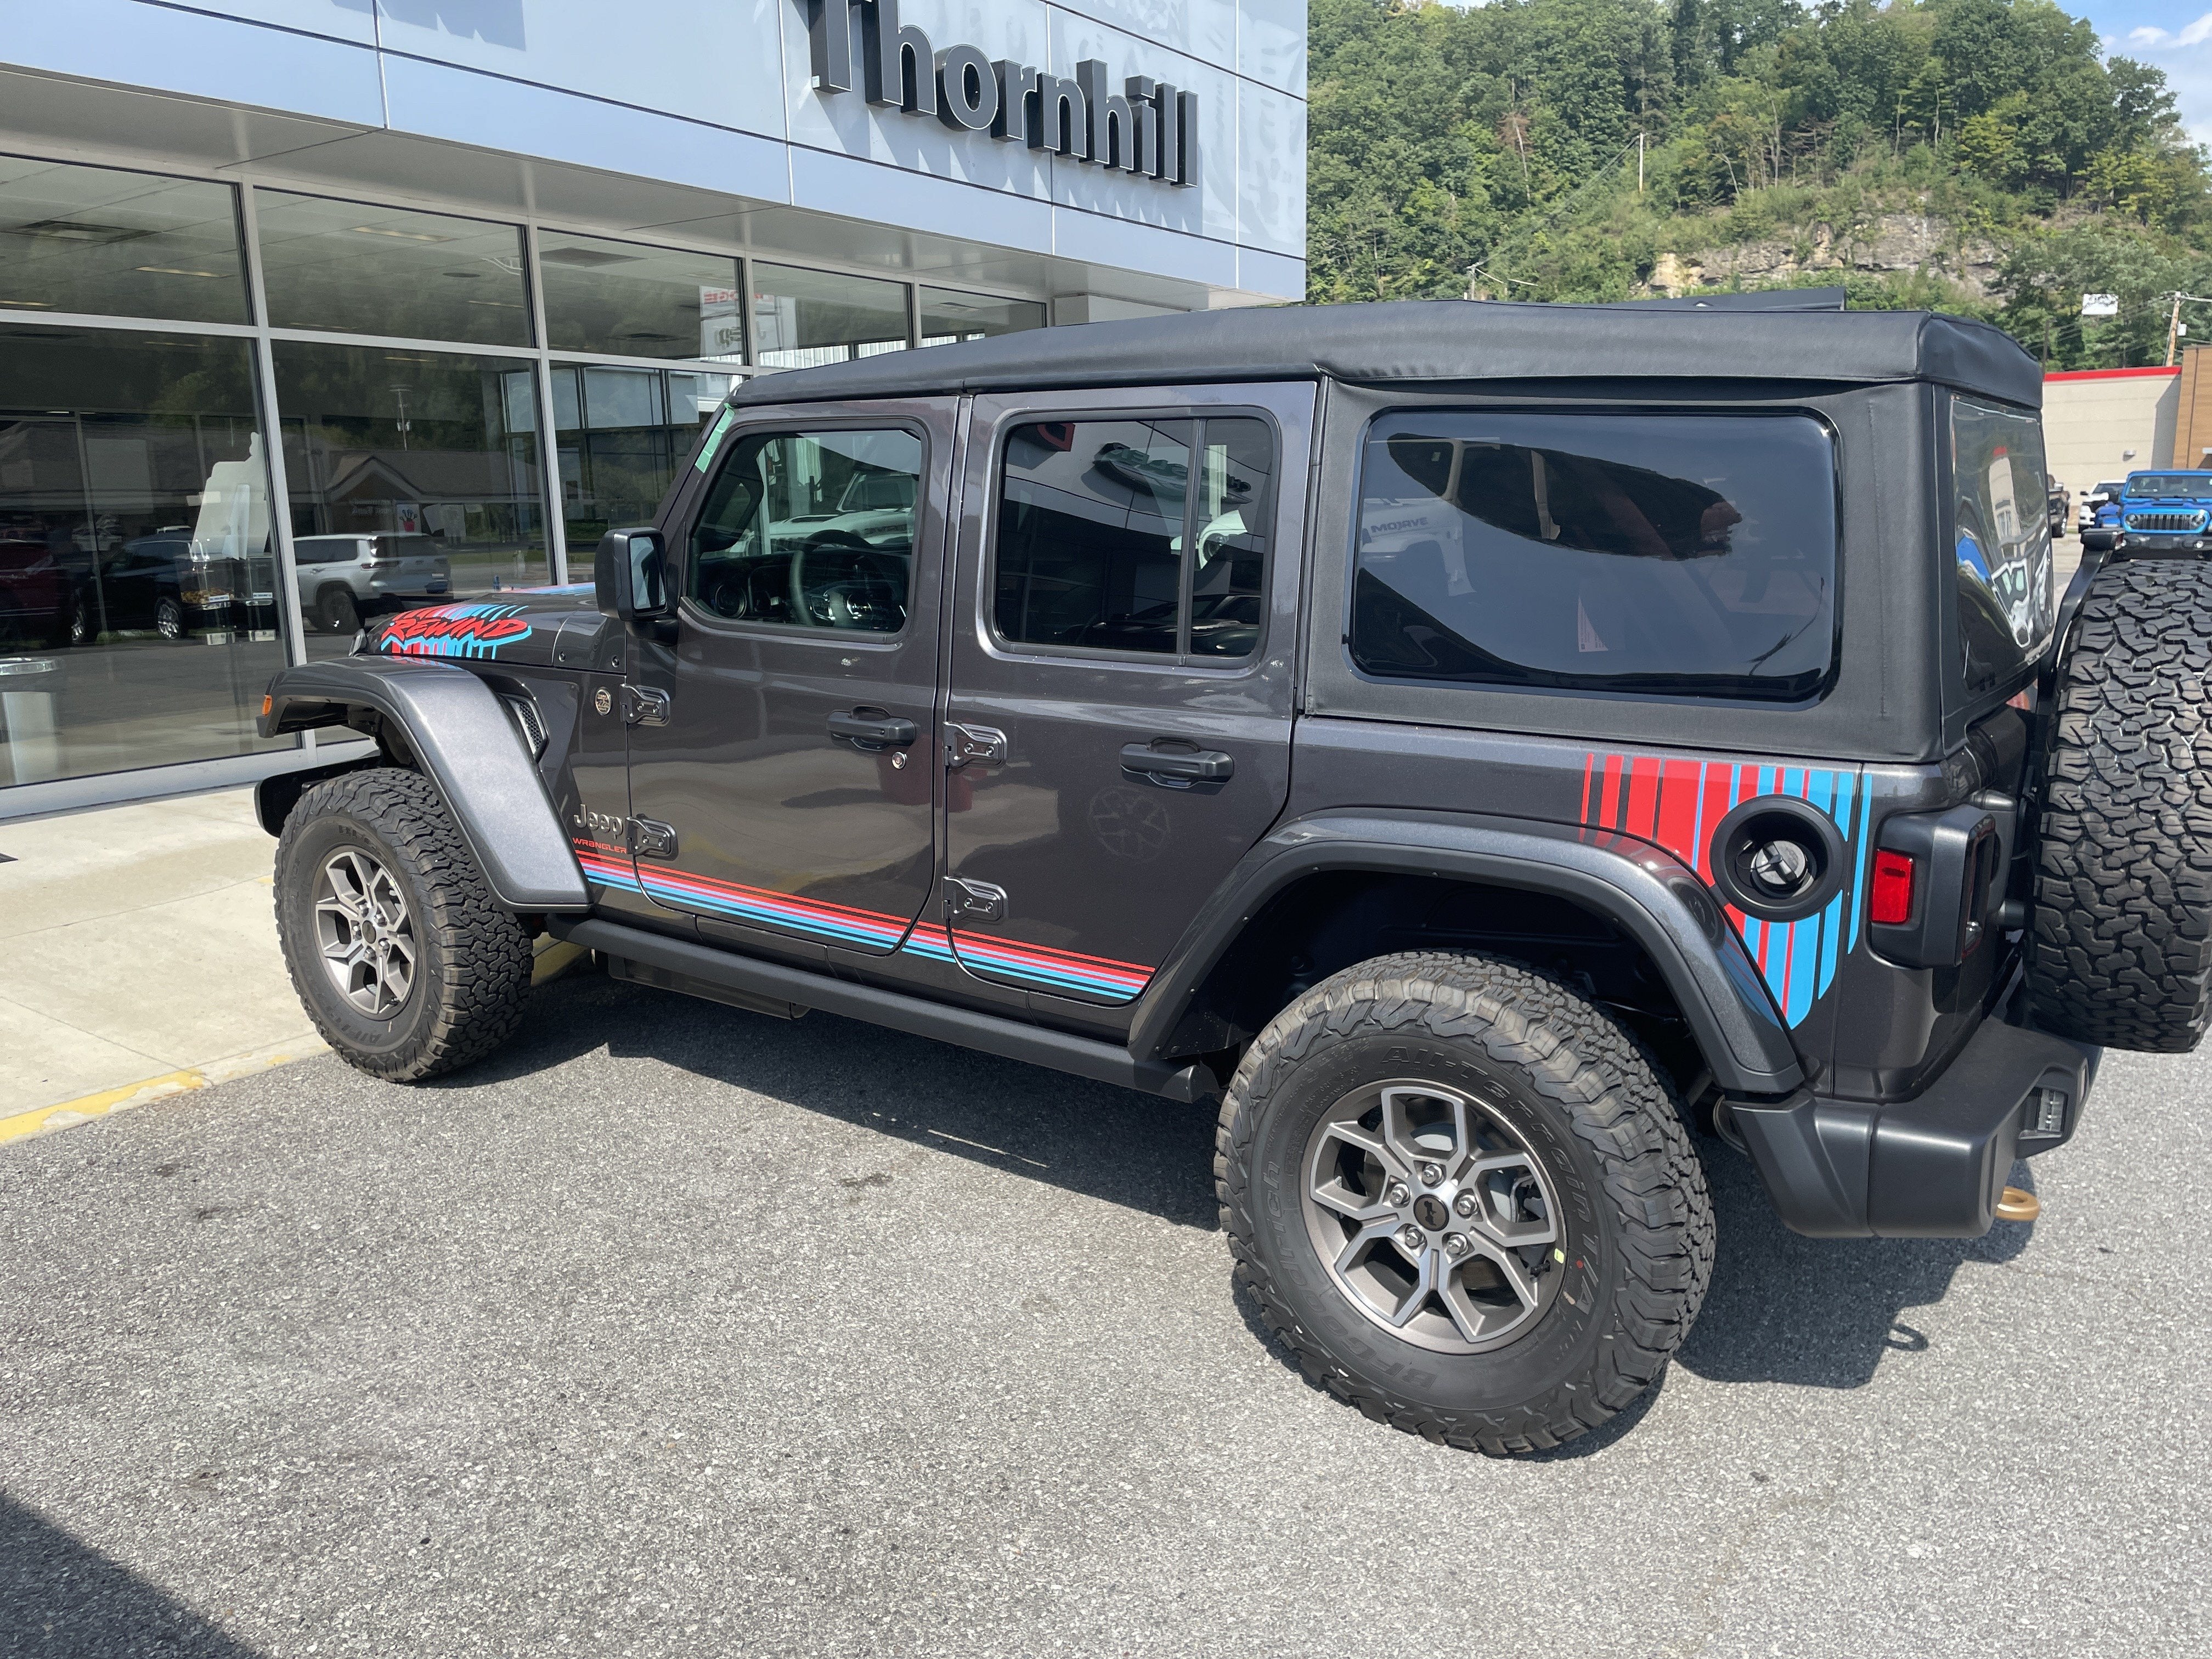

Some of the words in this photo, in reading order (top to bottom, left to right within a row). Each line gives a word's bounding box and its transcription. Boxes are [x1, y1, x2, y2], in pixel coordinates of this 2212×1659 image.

[808, 0, 1198, 188] Thornhill
[1370, 517, 1428, 533] MOJAVE
[381, 617, 527, 641] REWIND
[573, 804, 623, 840] Jeep
[1381, 1046, 1590, 1223] All-Terrain
[1263, 1161, 1437, 1390] BFGoodrich
